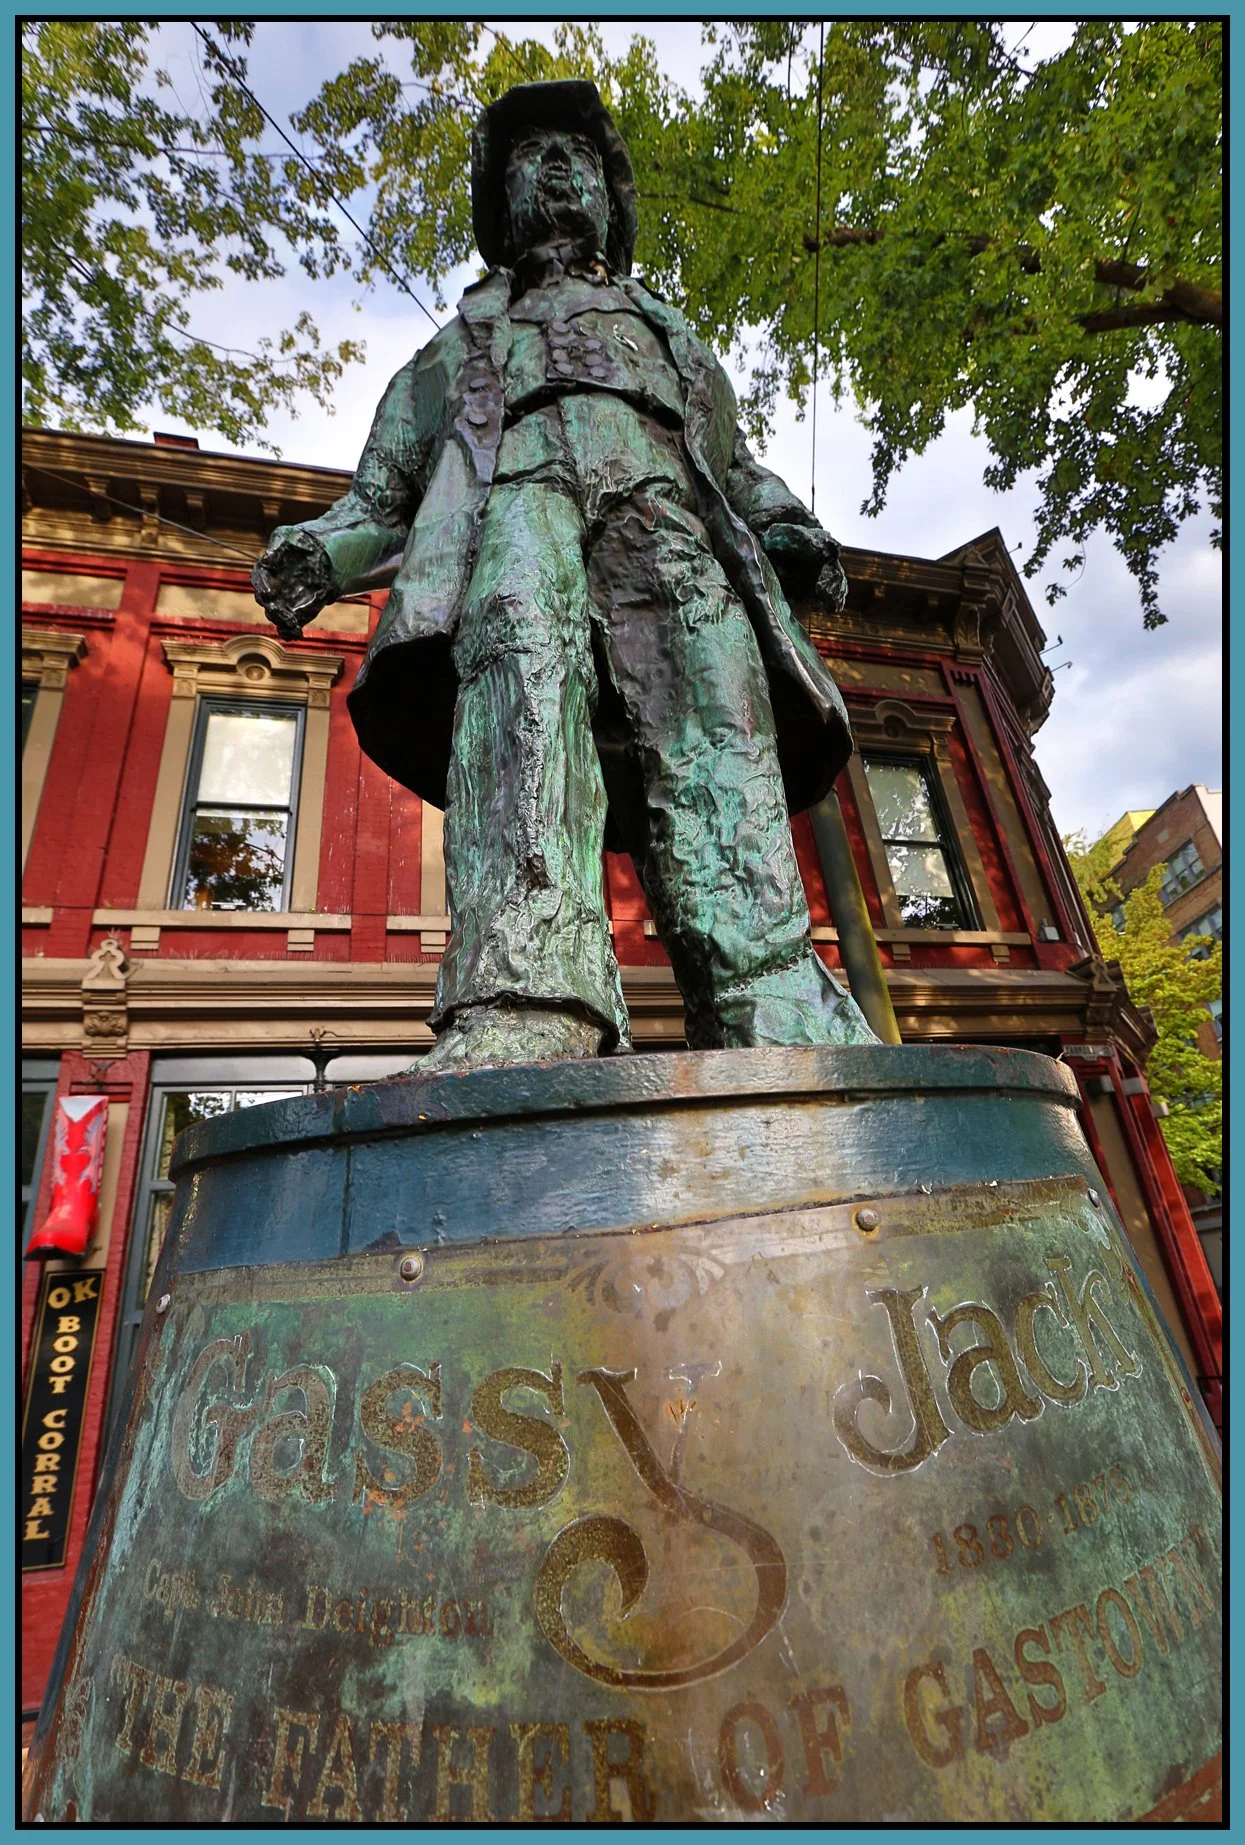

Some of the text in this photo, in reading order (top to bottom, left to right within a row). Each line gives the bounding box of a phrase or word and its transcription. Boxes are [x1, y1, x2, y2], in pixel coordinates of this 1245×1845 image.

[24, 1277, 98, 1536] OK BOOT CORRAL
[172, 1256, 1143, 1692] Gassy Jack
[110, 1524, 1215, 1822] THE FATHER OF GASTOWN
[301, 1584, 493, 1649] Deighton
